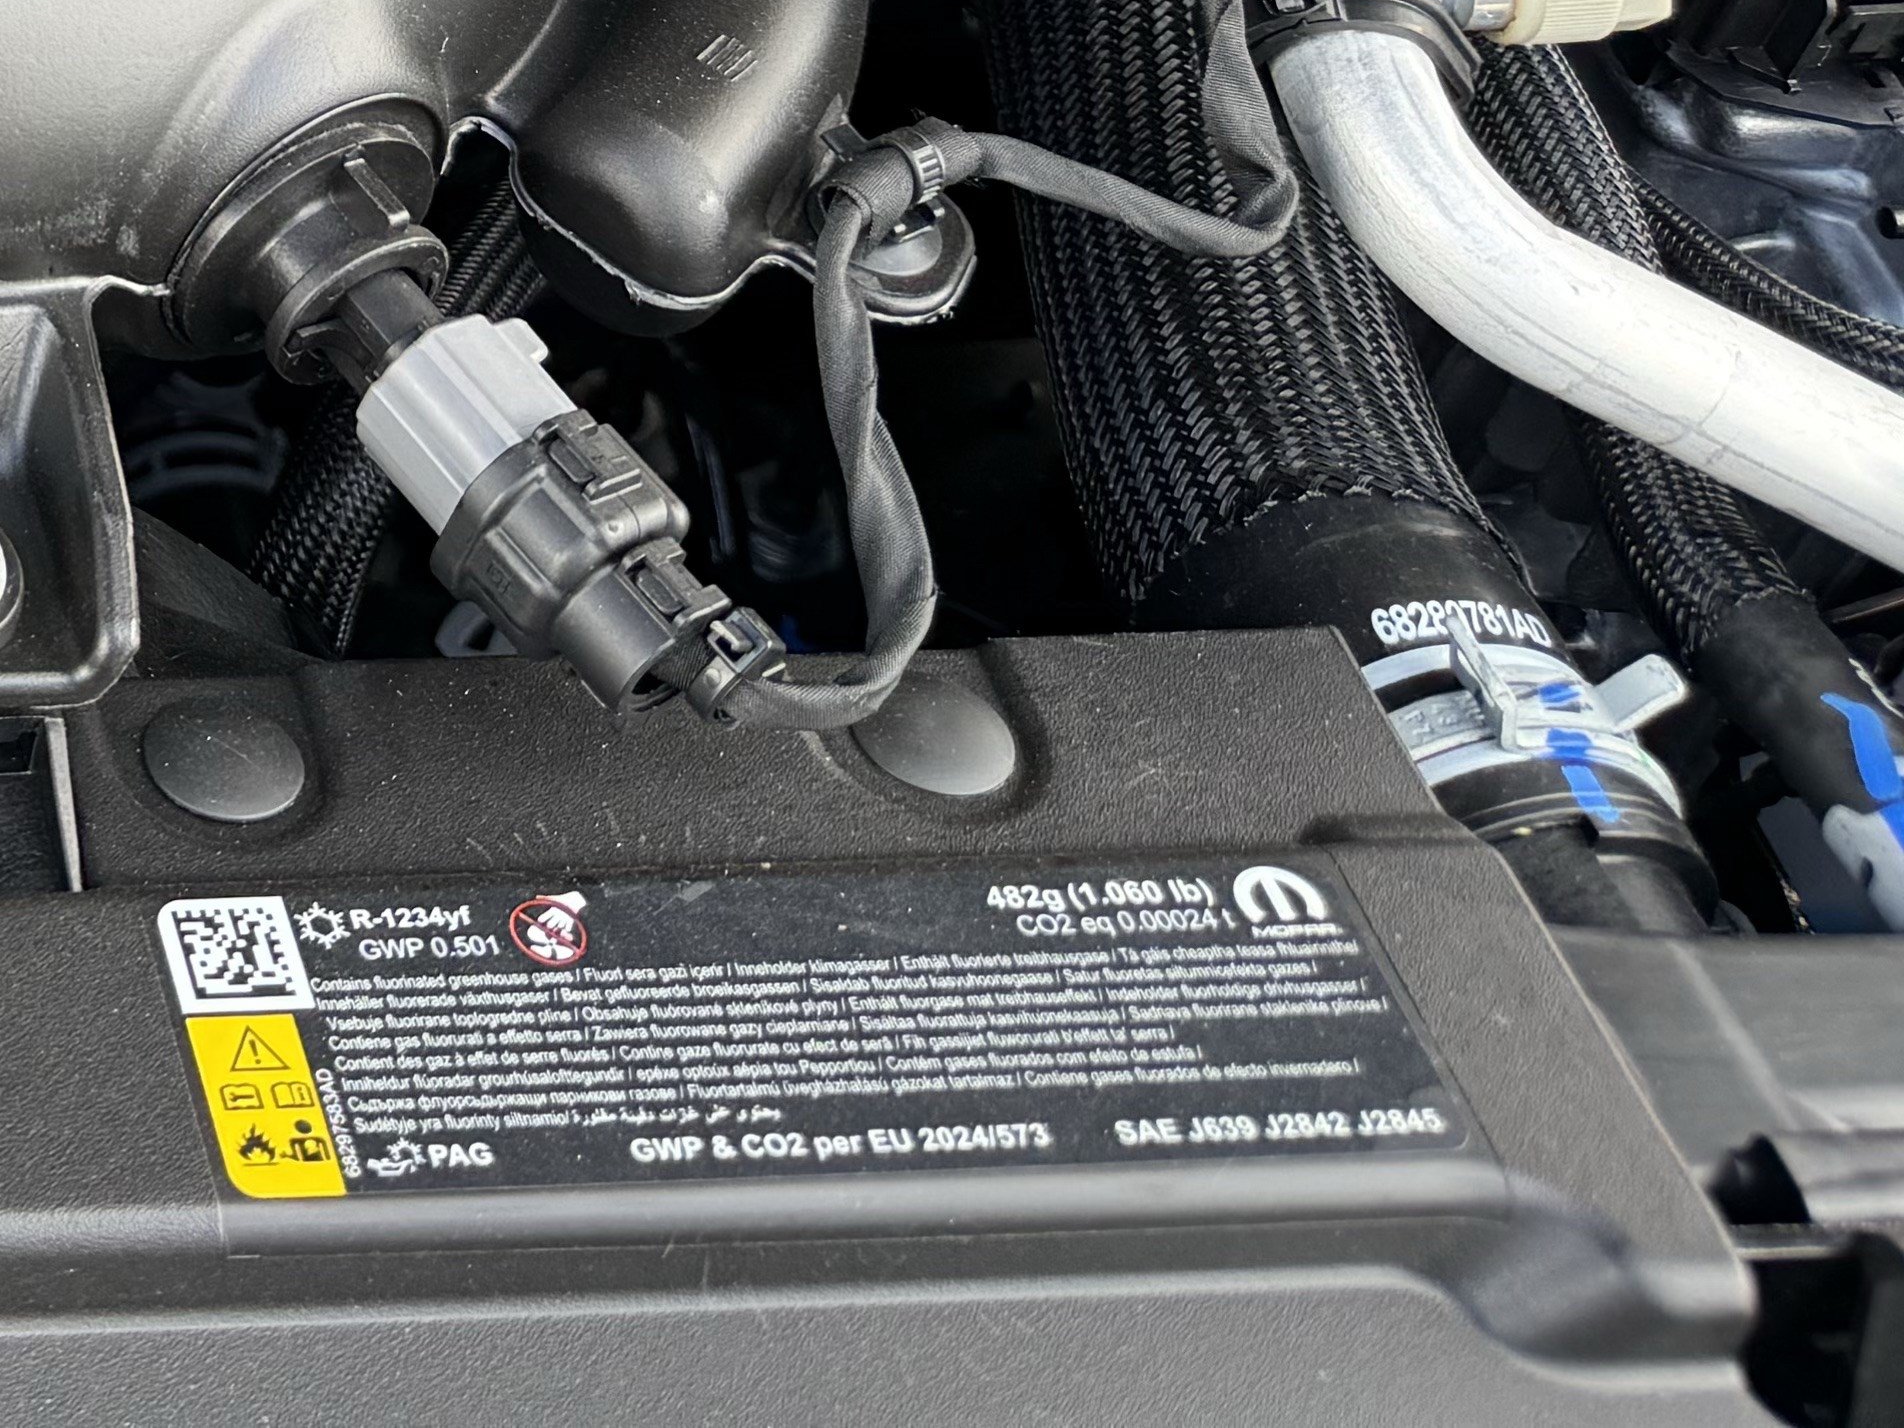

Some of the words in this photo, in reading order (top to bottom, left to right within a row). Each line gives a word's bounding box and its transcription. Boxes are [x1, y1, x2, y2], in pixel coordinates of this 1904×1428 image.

[986, 884, 1067, 914] 482g
[1068, 881, 1163, 912] (1.060
[1169, 878, 1213, 907] lb)
[349, 905, 472, 930] R-1234yf
[1015, 914, 1076, 937] CO2
[1081, 916, 1115, 938] eq
[1117, 909, 1217, 932] 0.00024
[1221, 908, 1236, 929] t
[358, 939, 424, 960] GWP
[430, 935, 501, 958] 0.501
[316, 1069, 362, 1177] 68297583AD
[1114, 1116, 1183, 1146] SAE
[1188, 1114, 1262, 1143] J639
[1264, 1110, 1354, 1140] J2842
[1356, 1107, 1446, 1137] J2845
[428, 1142, 494, 1167] PAG
[630, 1135, 704, 1162] GWP
[712, 1134, 739, 1159] &
[741, 1132, 809, 1158] CO2
[813, 1134, 862, 1161] per
[867, 1128, 917, 1154] EU
[918, 1122, 1053, 1151] 2024/573
